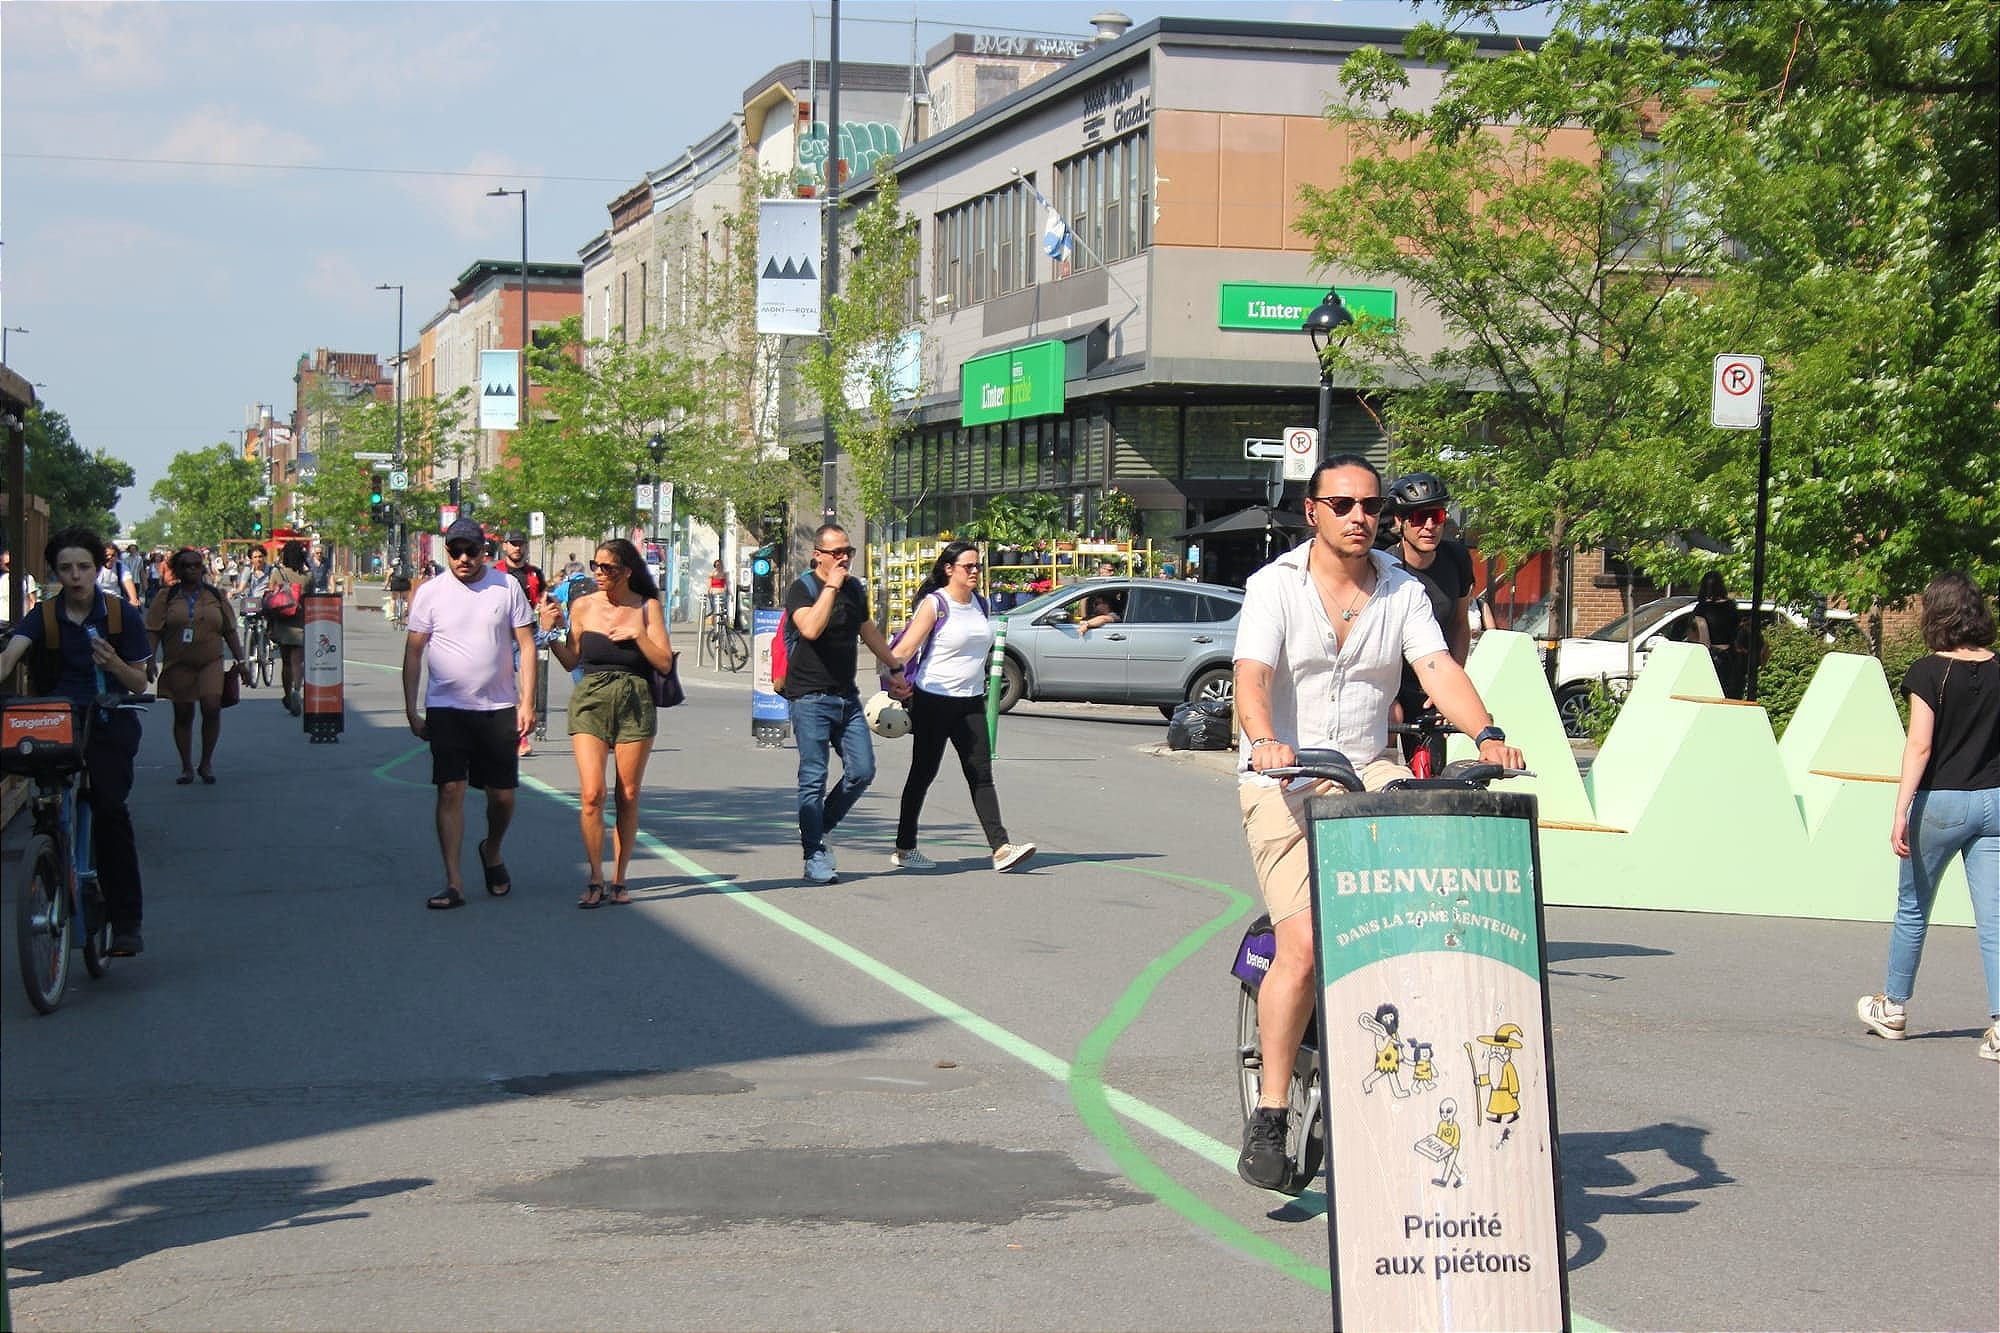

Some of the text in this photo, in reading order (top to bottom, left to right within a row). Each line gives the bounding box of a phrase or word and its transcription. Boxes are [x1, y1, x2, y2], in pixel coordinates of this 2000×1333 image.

[8, 715, 60, 729] Tangerine
[1336, 868, 1522, 896] BIENVENUE
[1335, 918, 1380, 947] DANS
[1382, 913, 1404, 929] LA
[1405, 909, 1450, 928] ZONE
[1403, 1211, 1503, 1240] Priorité
[1374, 1247, 1532, 1281] aux piétons
